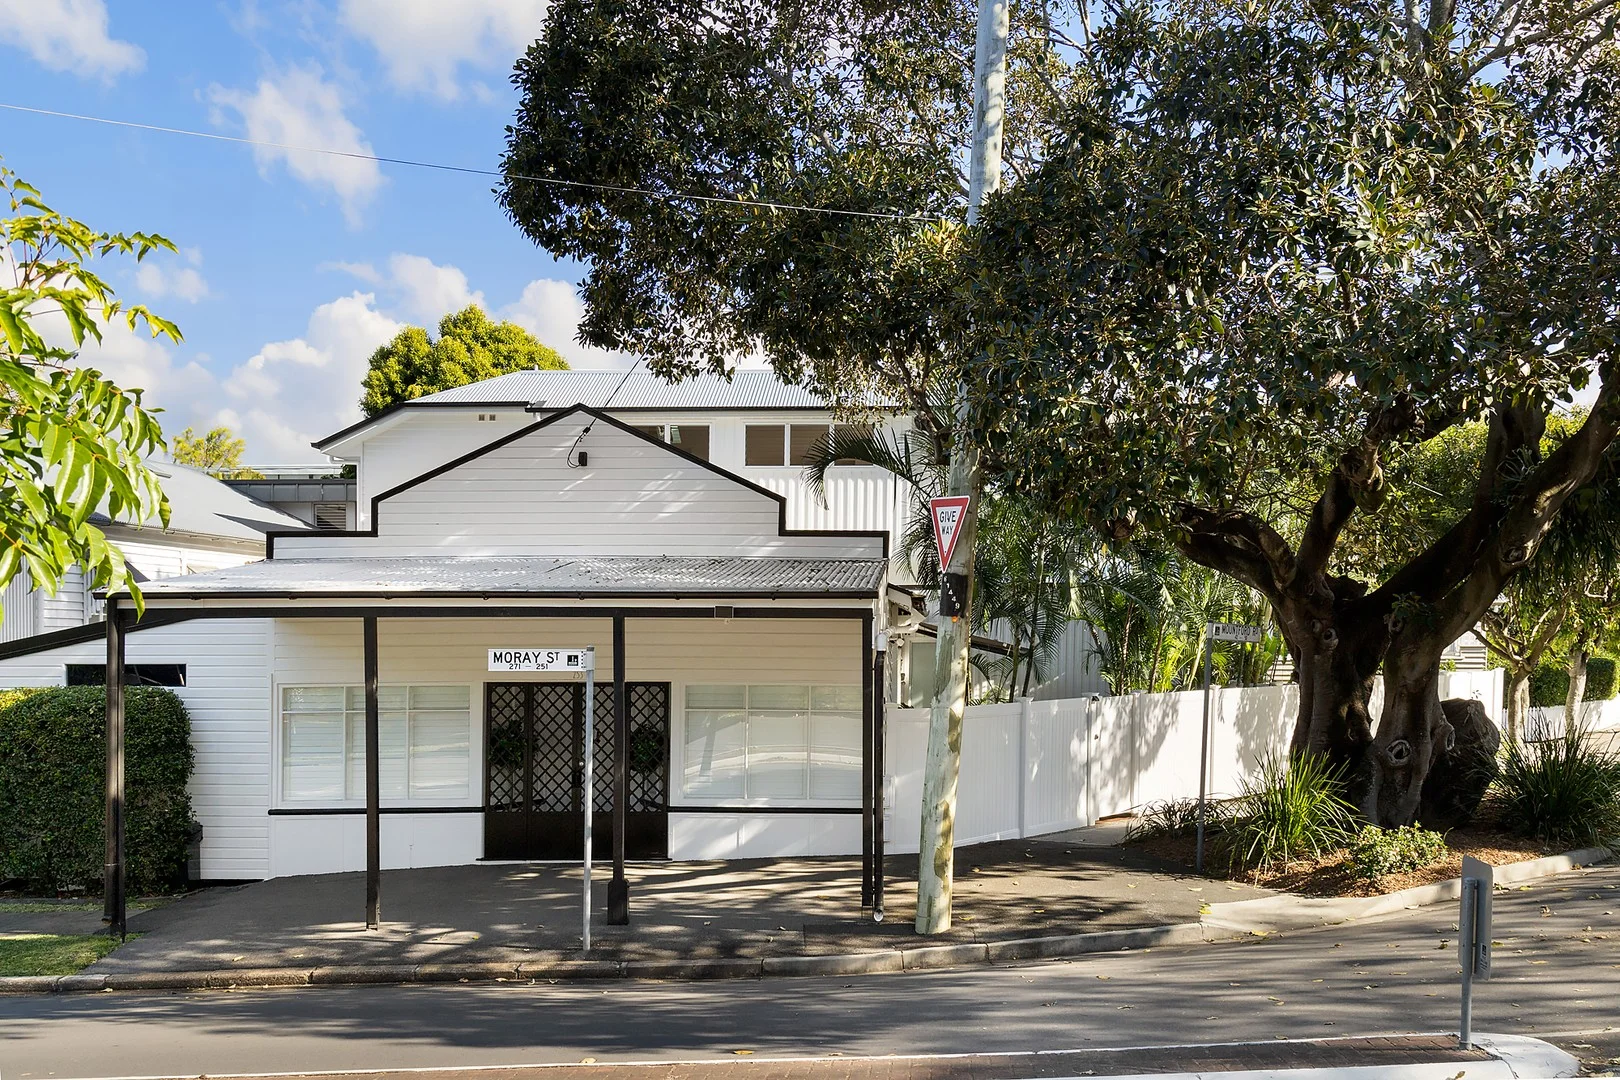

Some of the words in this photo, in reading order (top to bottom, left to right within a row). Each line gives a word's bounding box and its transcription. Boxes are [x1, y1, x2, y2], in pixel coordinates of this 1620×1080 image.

[940, 511, 956, 522] GIVE
[942, 526, 953, 535] WAY
[1222, 625, 1251, 635] MOUNTFORD
[493, 652, 541, 663] MORAY
[547, 651, 560, 663] ST
